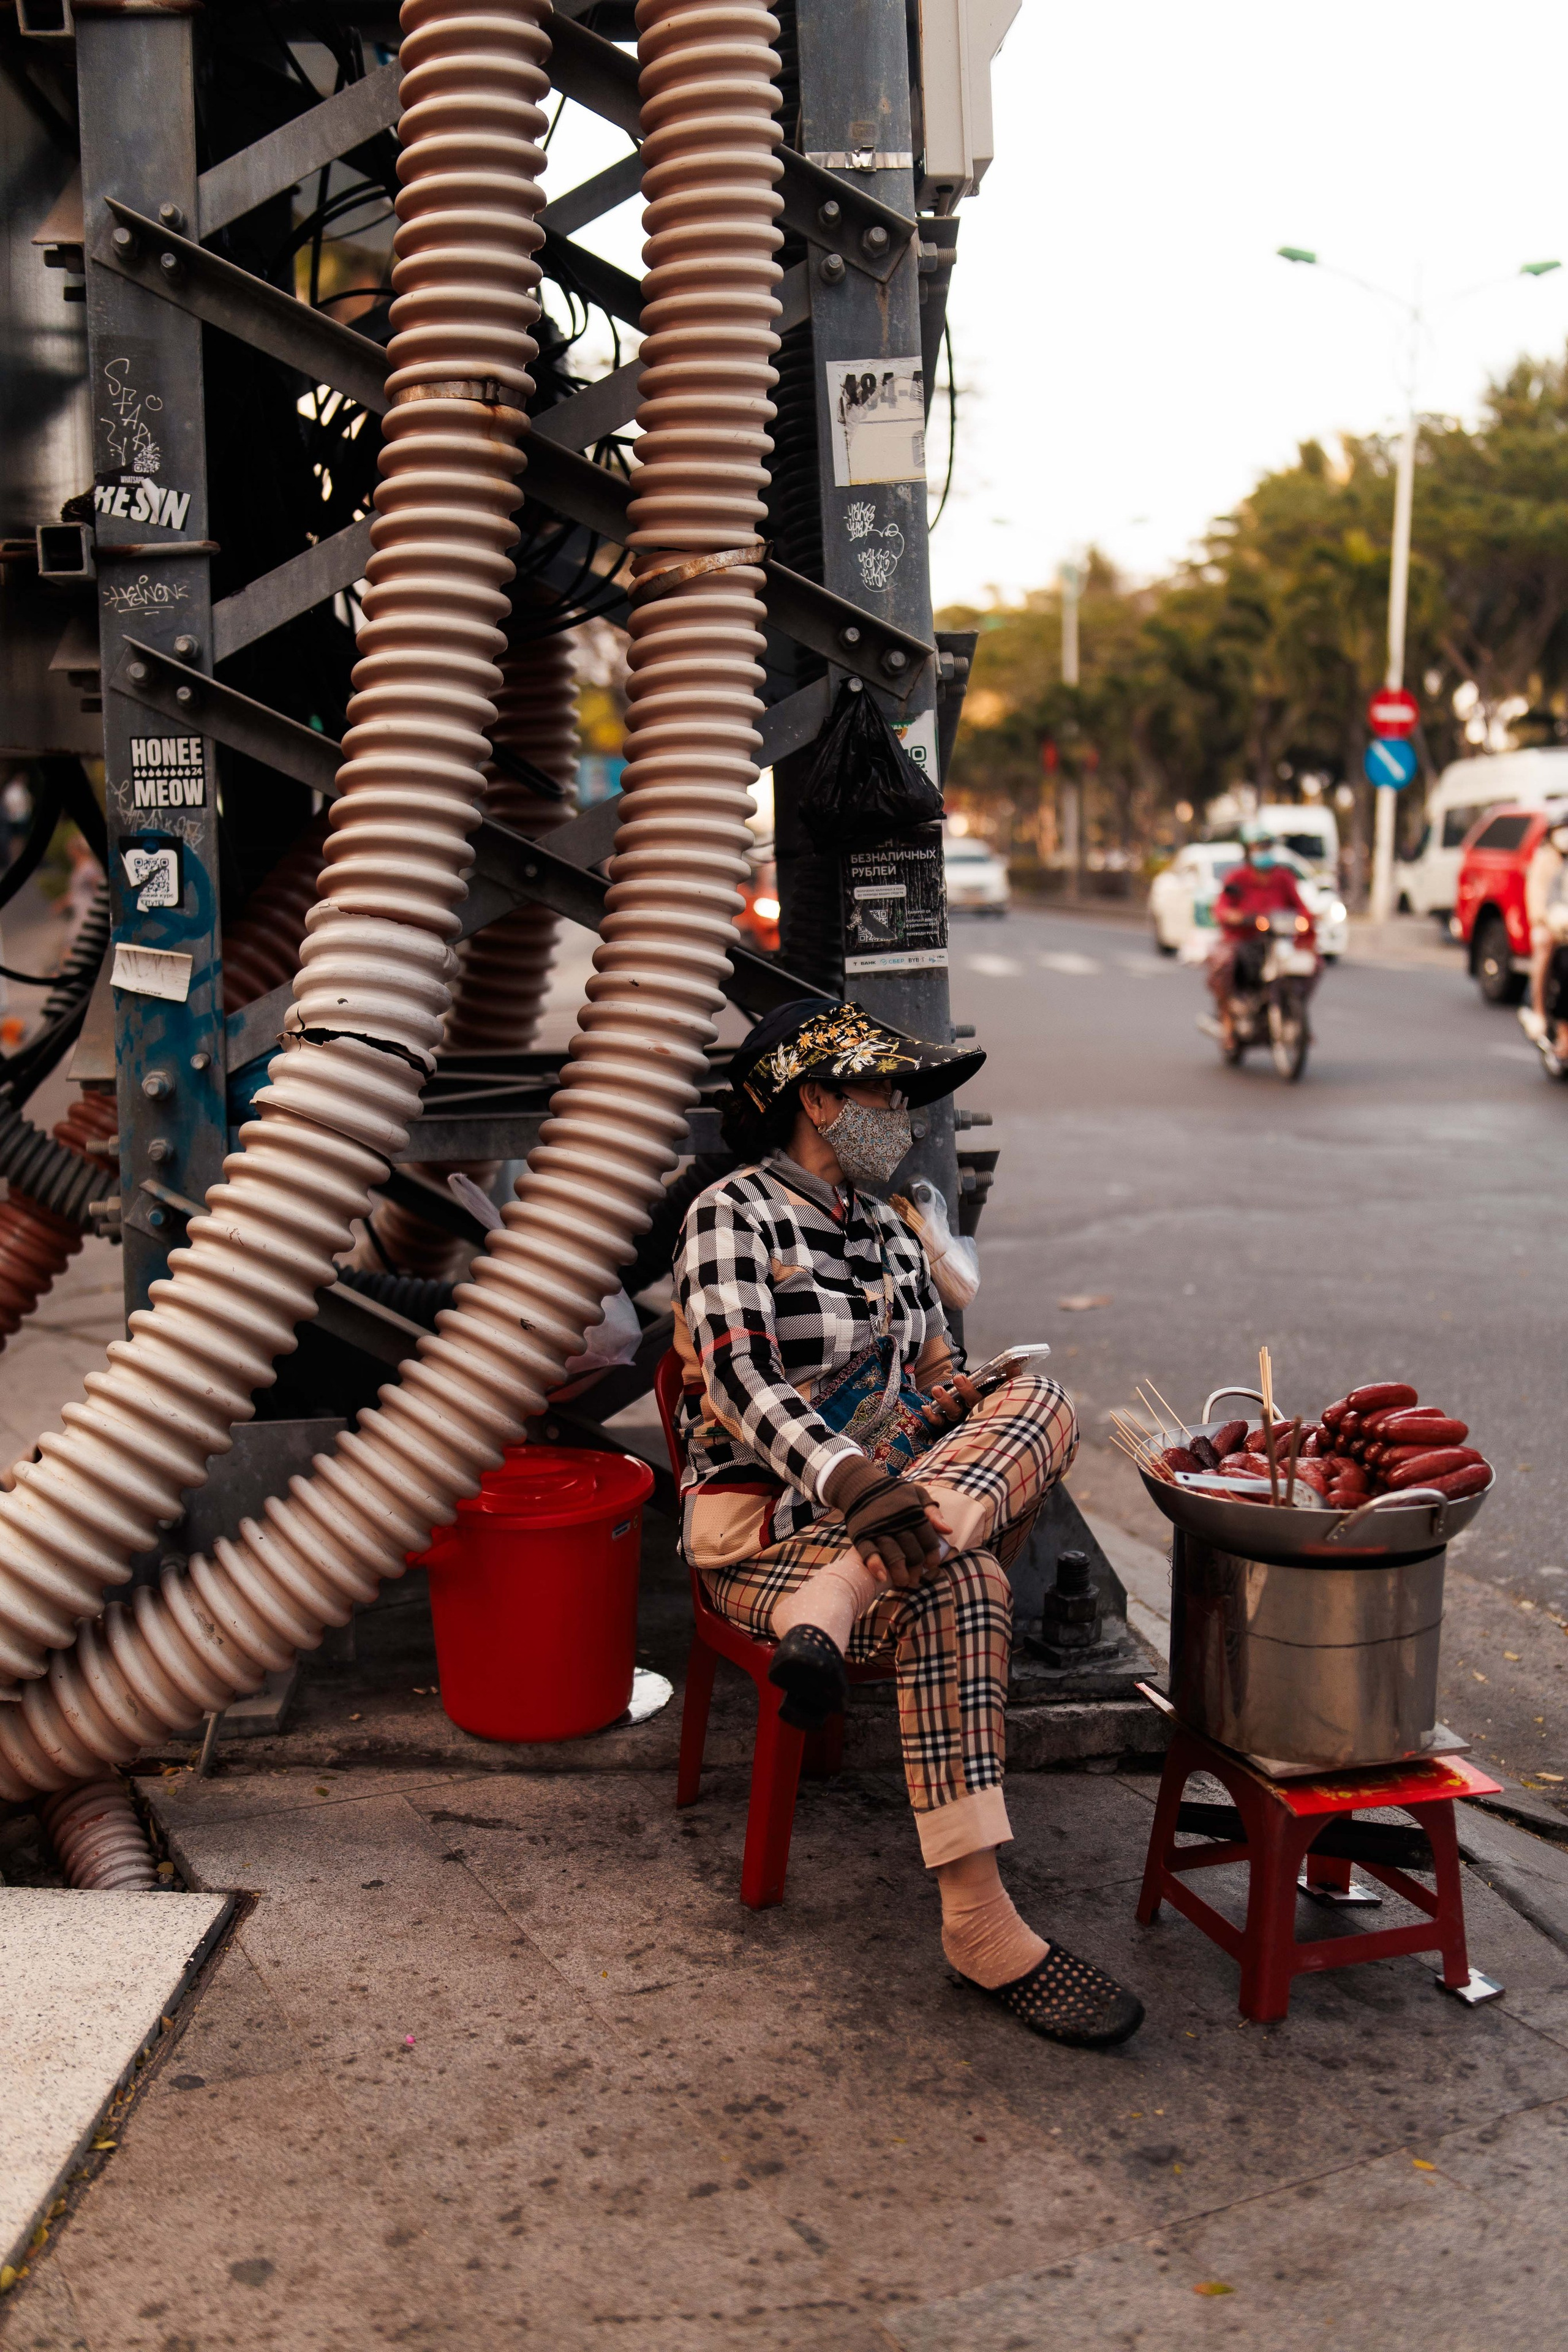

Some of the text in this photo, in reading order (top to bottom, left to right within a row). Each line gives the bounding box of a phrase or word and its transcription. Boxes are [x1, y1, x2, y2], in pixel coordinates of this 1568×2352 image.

[132, 737, 203, 767] HONEE
[191, 767, 202, 775] 24
[134, 778, 204, 807] MEOW
[851, 850, 937, 864] БЕЗНАЛИЧНЫХ
[851, 863, 896, 877] РУБЛЕЙ
